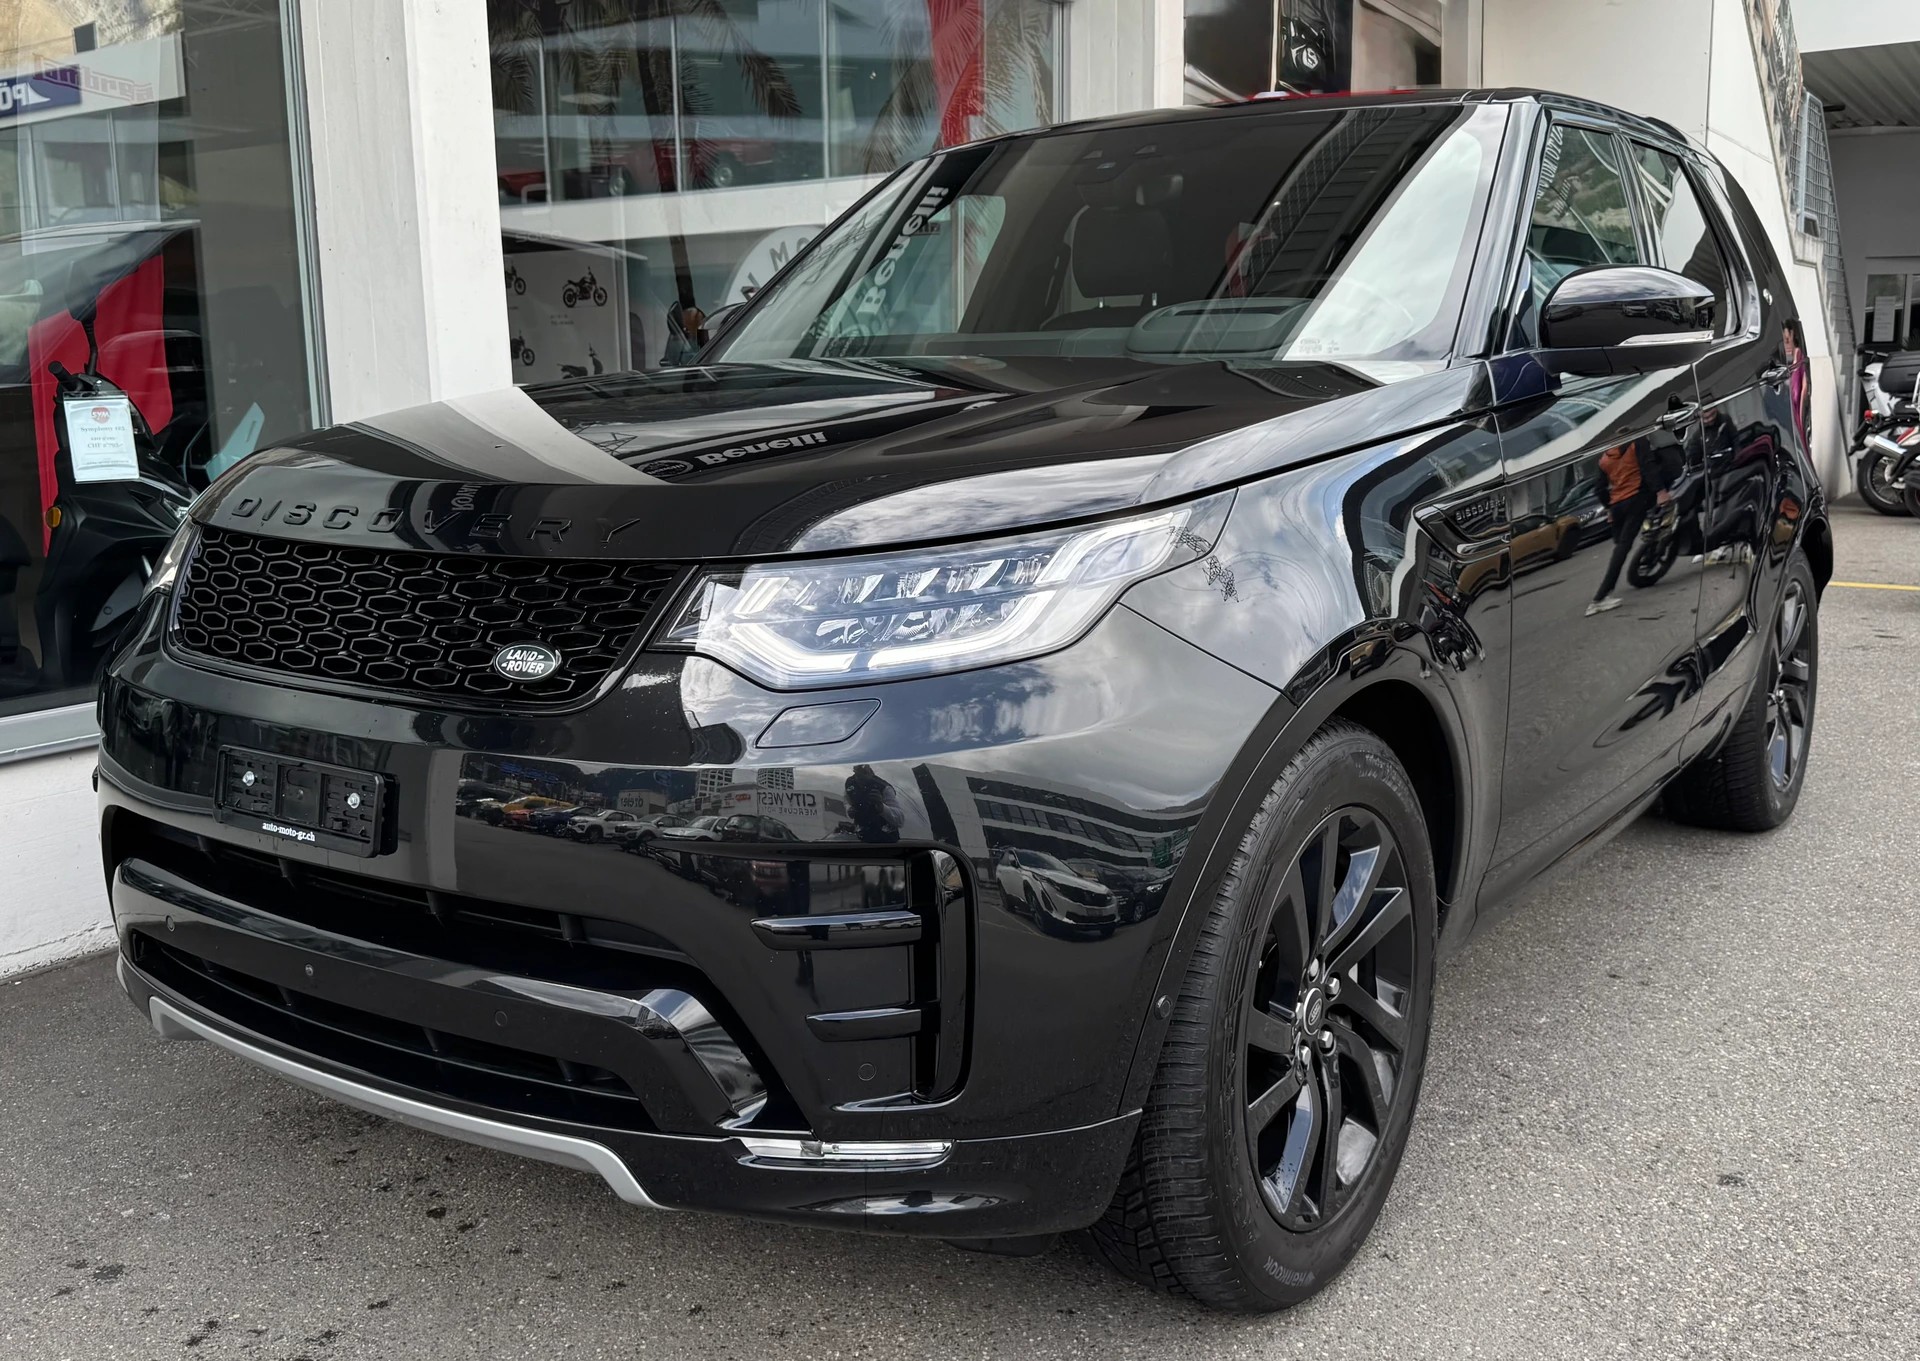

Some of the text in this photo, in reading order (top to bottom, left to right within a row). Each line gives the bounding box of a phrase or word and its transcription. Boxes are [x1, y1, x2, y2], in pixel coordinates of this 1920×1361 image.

[231, 498, 641, 546] DISCOVERY
[506, 649, 538, 661] LAND
[506, 660, 545, 673] ROVER
[262, 822, 316, 842] auto-moto-gr.ch
